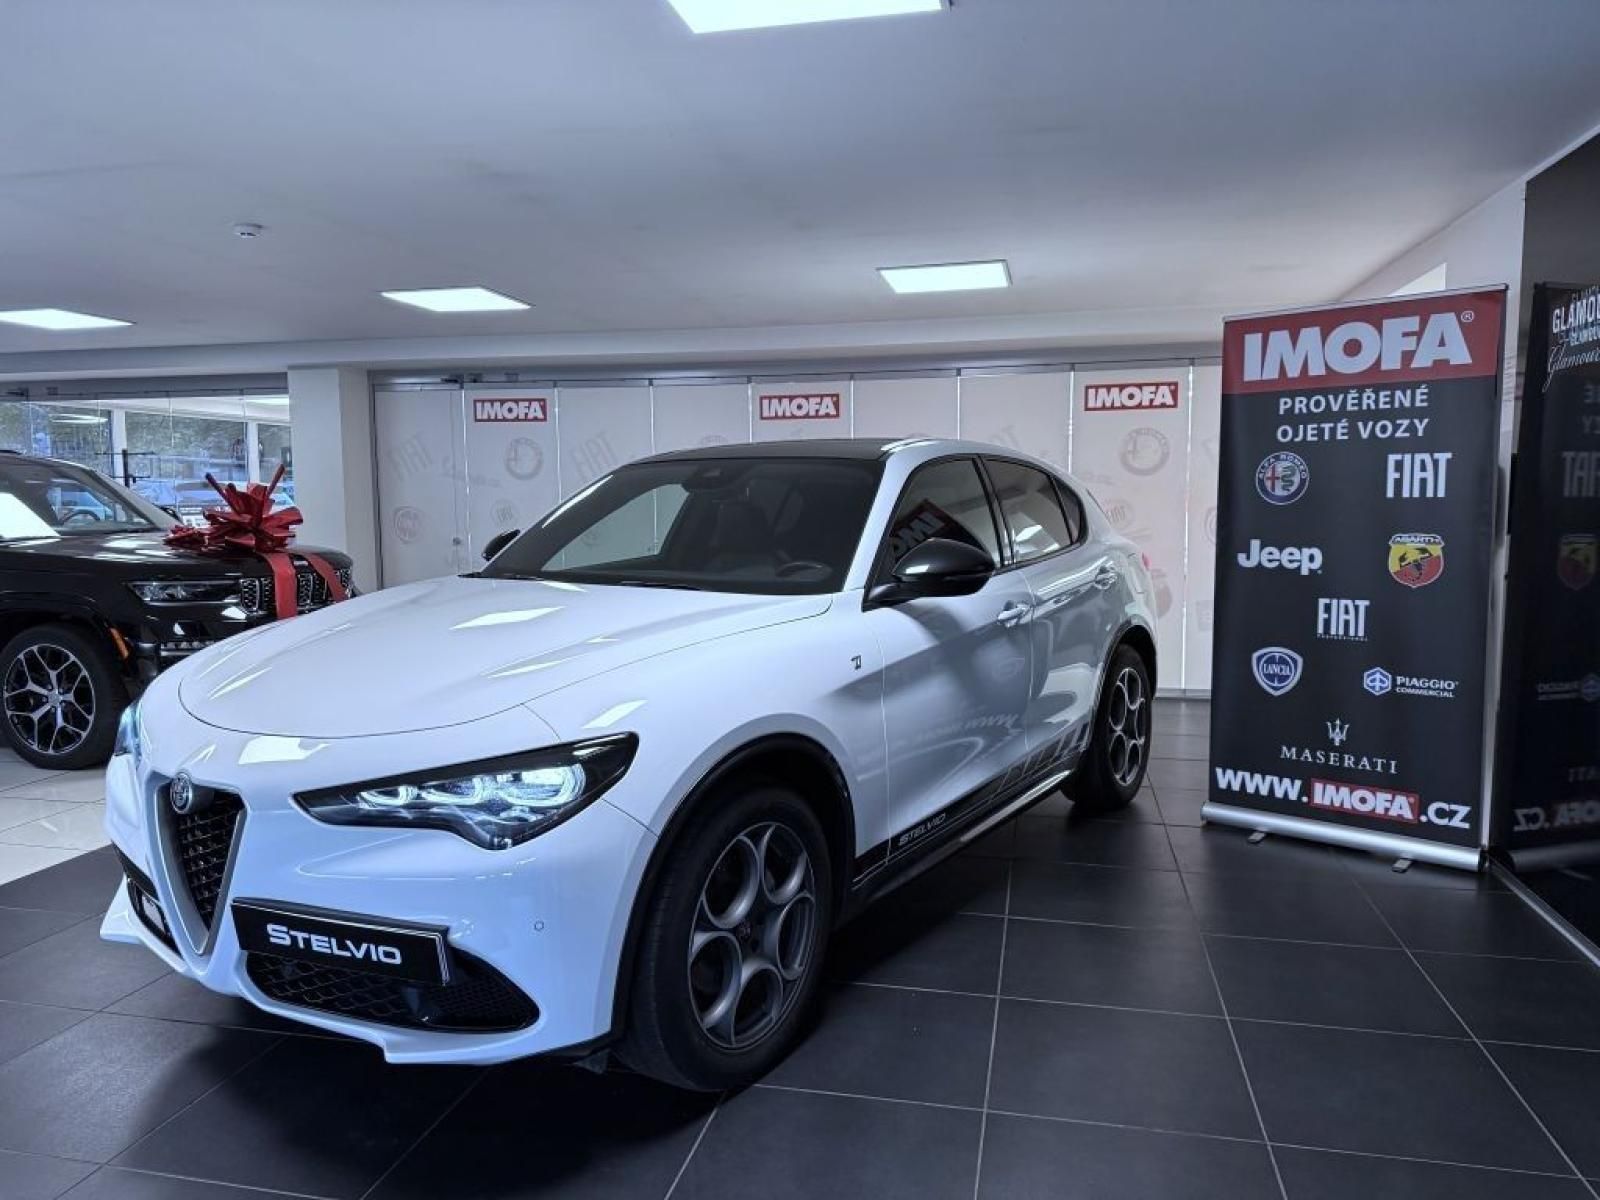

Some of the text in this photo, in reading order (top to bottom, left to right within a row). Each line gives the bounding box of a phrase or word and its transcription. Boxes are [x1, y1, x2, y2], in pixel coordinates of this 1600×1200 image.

[1243, 311, 1473, 382] IMOFA
[475, 399, 545, 420] IMOFA
[761, 396, 837, 418] IMOFA
[1087, 385, 1174, 409] IMOFA
[1279, 384, 1429, 415] PROVĚŘENÉ
[1277, 417, 1430, 443] OJETÉ VOZY
[1386, 452, 1453, 498] FIAT
[1237, 539, 1322, 576] Jeep
[1317, 597, 1370, 635] FIAT
[1263, 664, 1292, 676] LANCIA
[1396, 675, 1456, 691] PIAGGIO
[1395, 686, 1454, 698] COMMERCIAL
[1280, 745, 1399, 774] MASERATI
[898, 813, 946, 846] STELVIO
[266, 923, 402, 965] STELVIO
